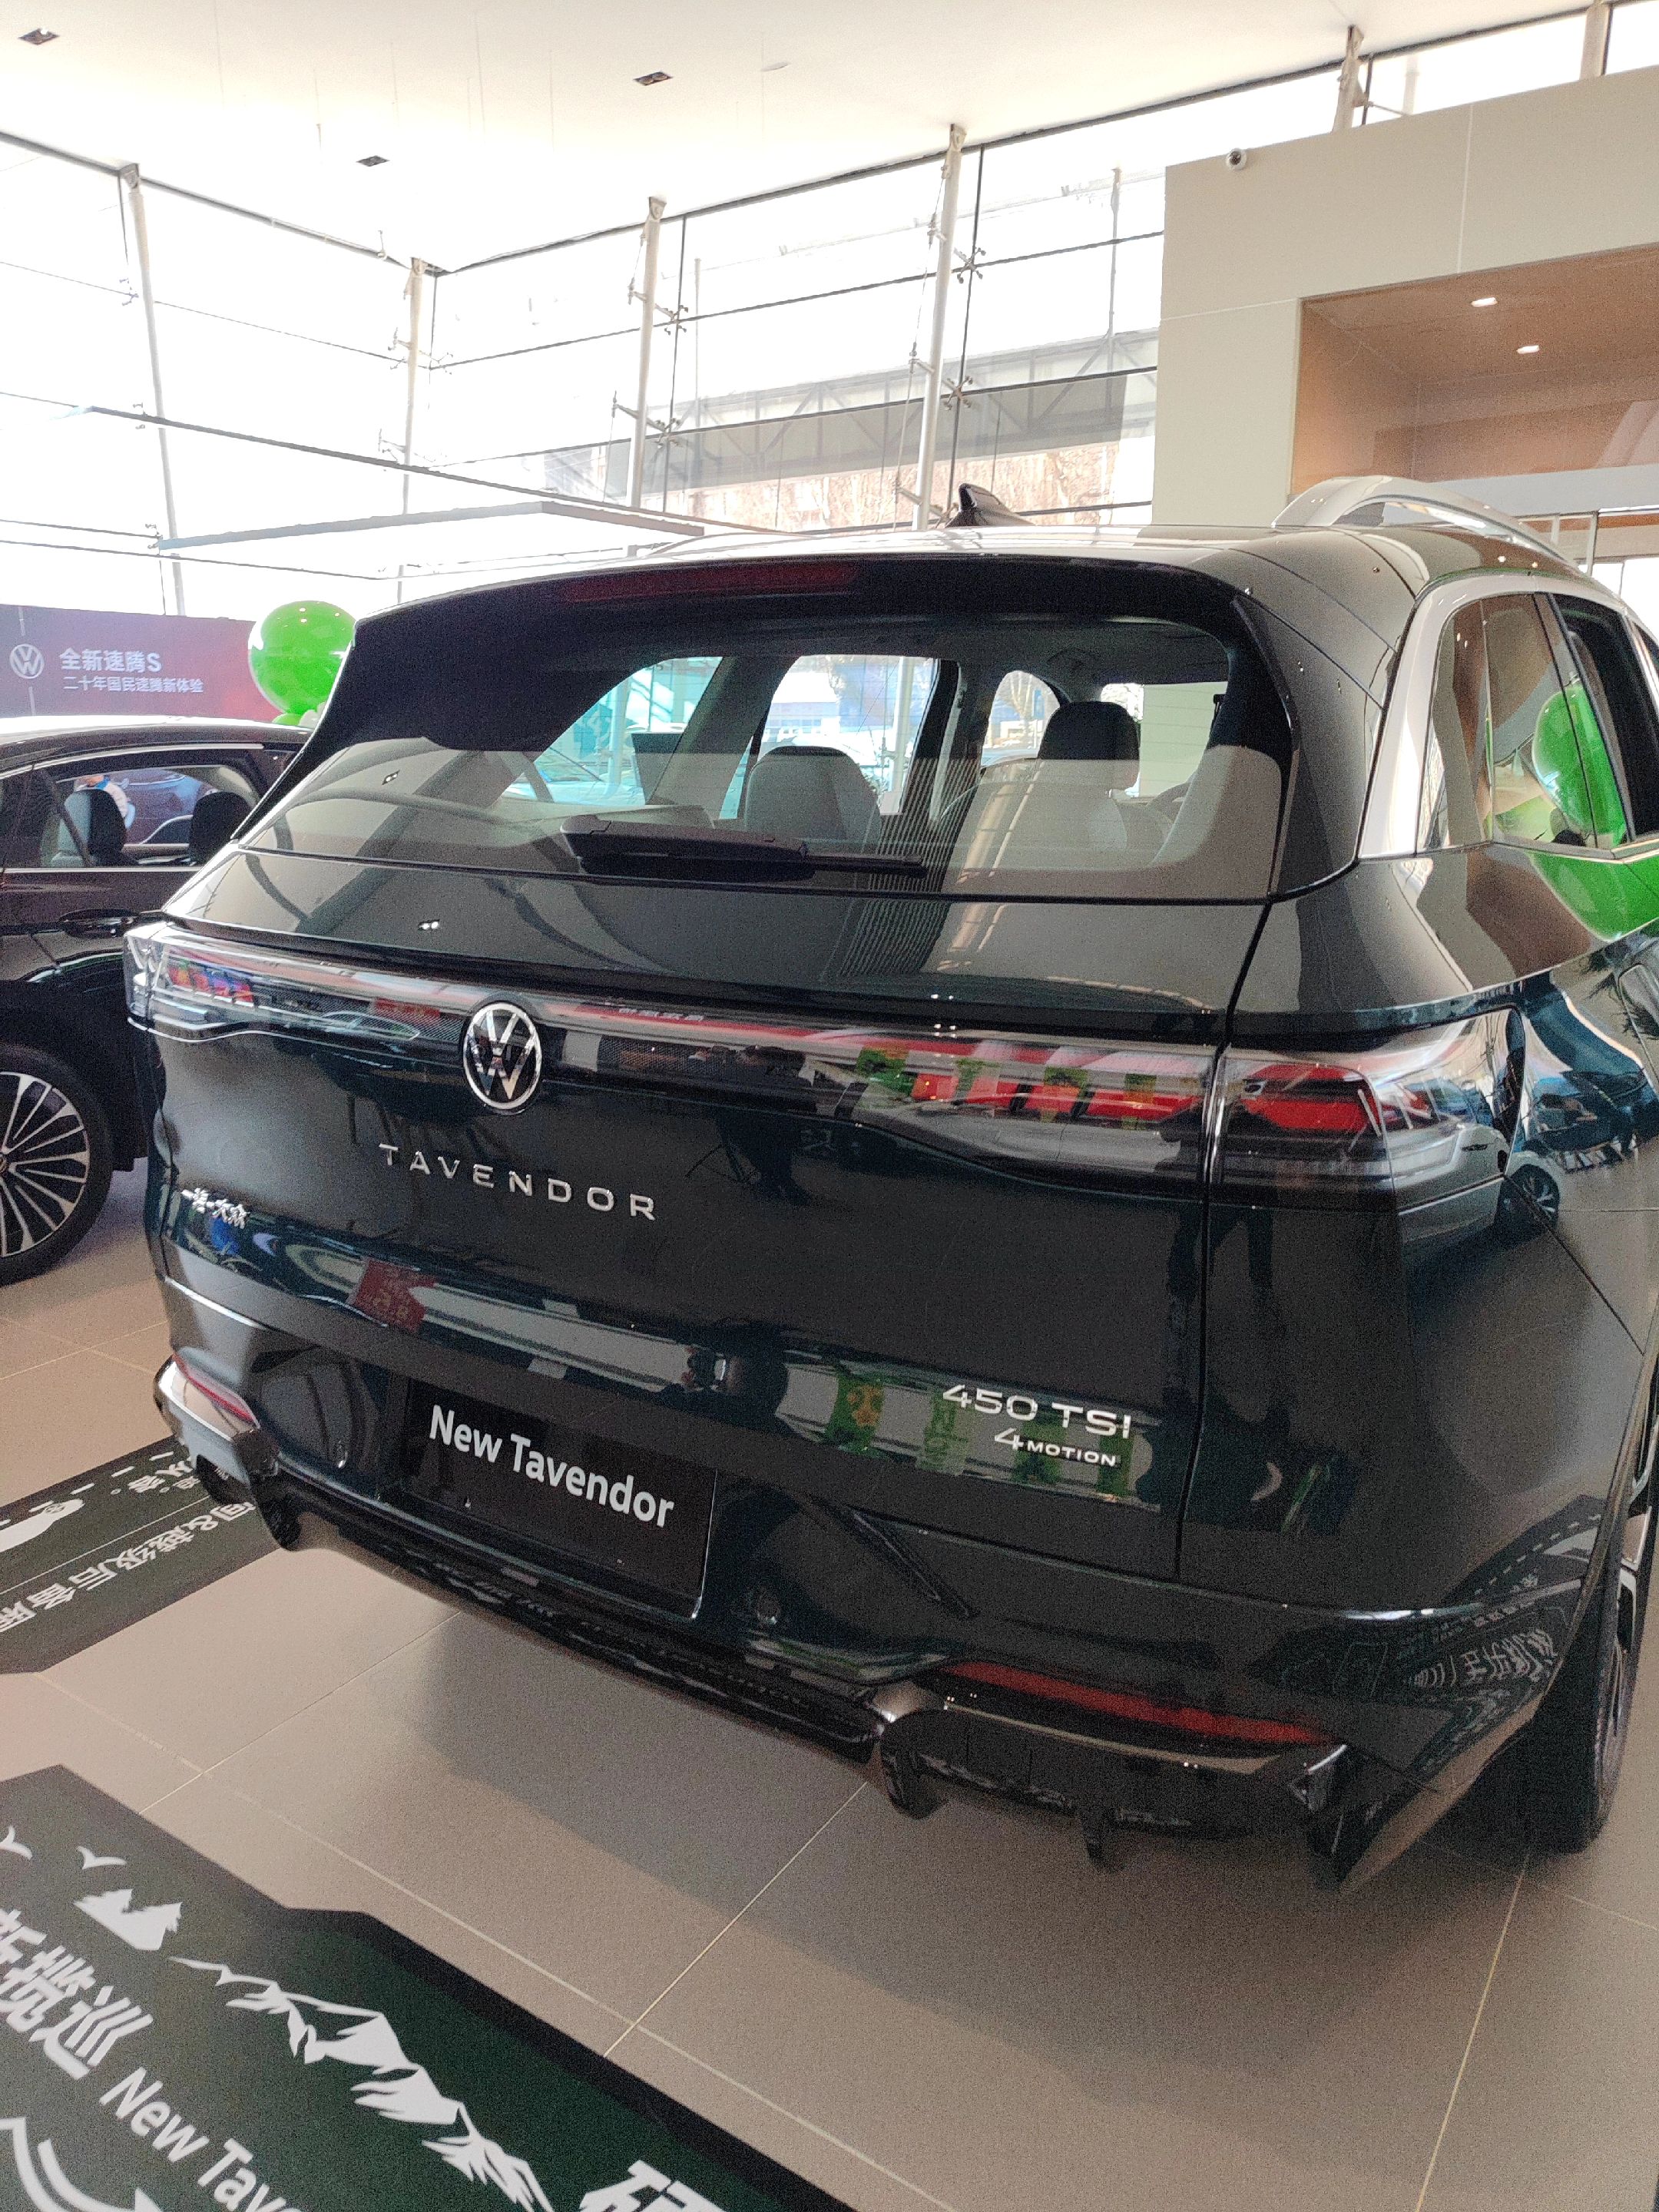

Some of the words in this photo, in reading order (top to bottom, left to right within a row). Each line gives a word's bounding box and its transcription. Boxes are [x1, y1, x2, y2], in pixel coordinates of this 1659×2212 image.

[59, 647, 162, 673] 全新速腾S
[379, 1143, 655, 1220] TAVENDOR
[942, 1385, 1038, 1421] 450
[1051, 1402, 1132, 1439] TSI
[429, 1404, 502, 1463] New
[510, 1433, 675, 1528] Tavendor
[994, 1427, 1116, 1467] 4MOTION
[98, 2066, 210, 2162] New
[197, 2137, 304, 2212] Tav
